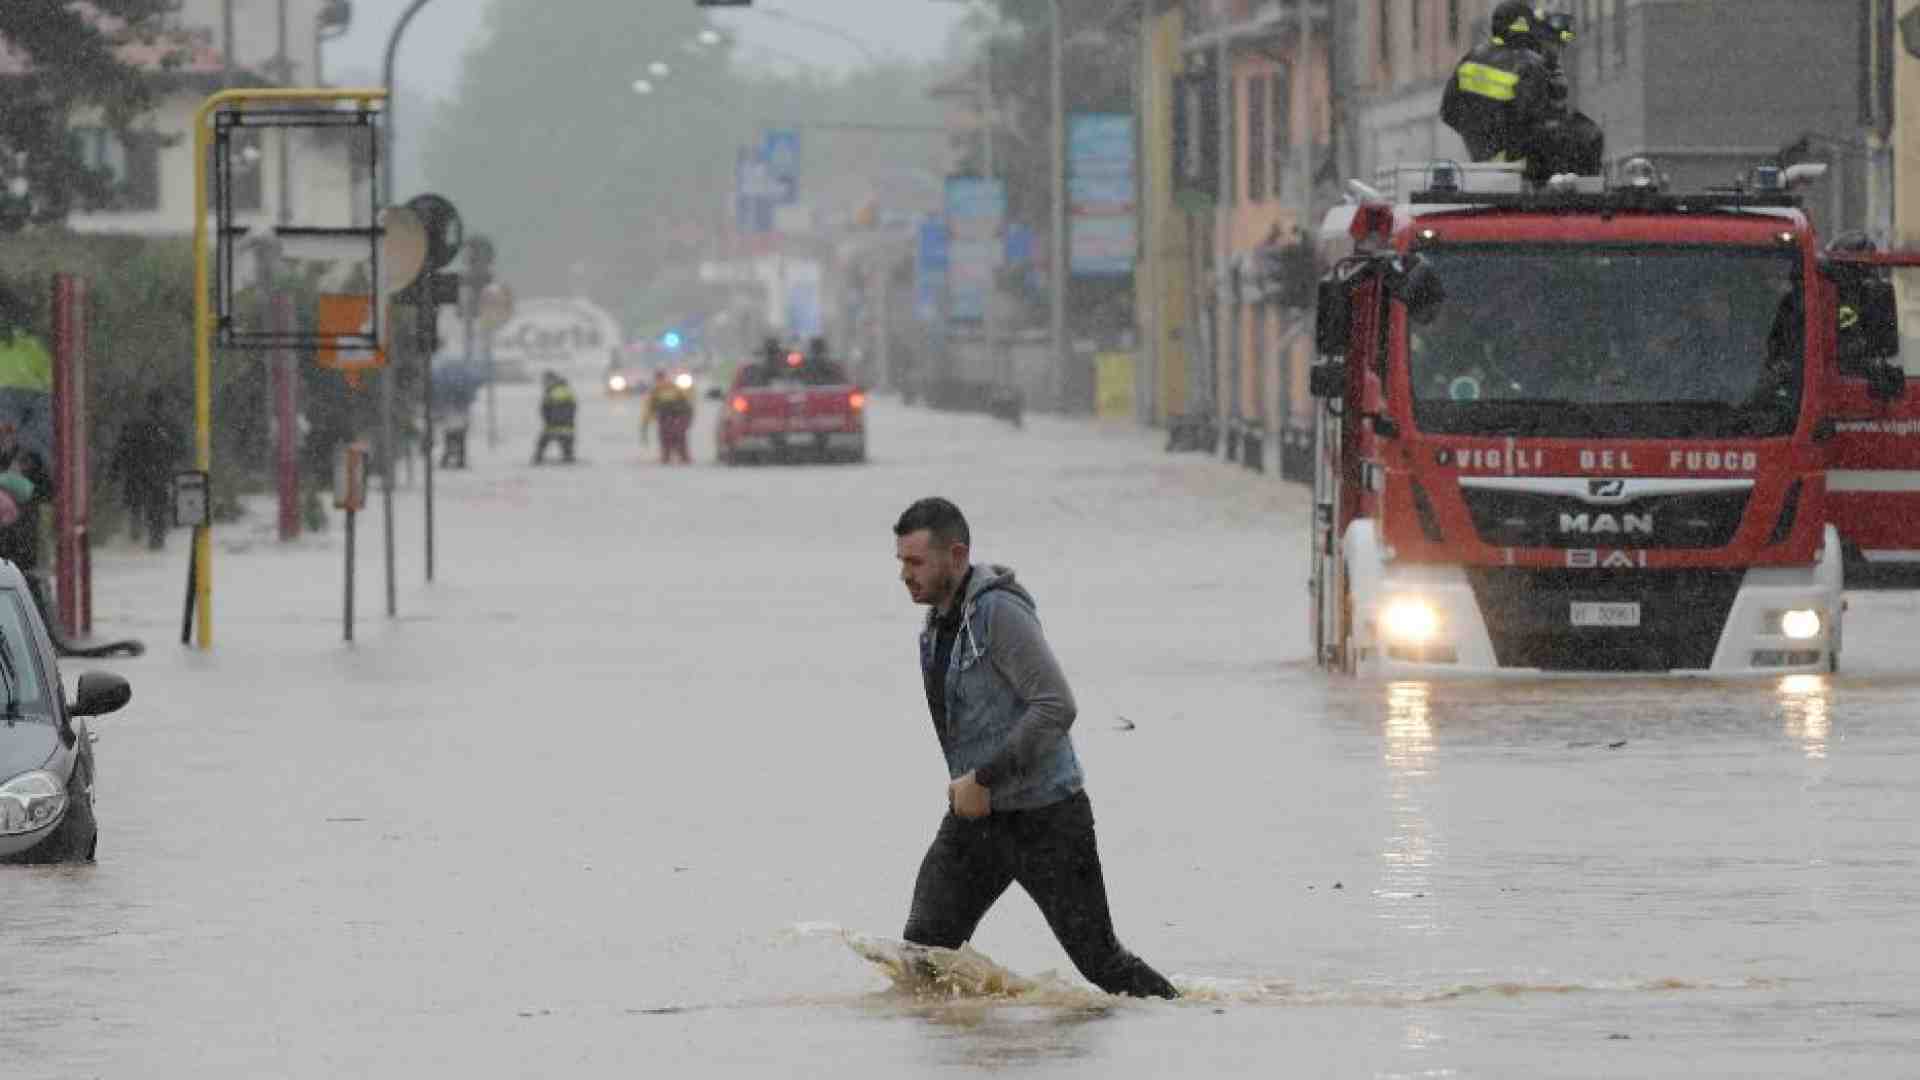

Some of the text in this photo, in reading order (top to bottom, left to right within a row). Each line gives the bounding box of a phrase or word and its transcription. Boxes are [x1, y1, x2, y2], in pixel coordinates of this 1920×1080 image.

[1456, 449, 1757, 470] VIGILI DEL FUOCO
[1559, 512, 1653, 533] MAN
